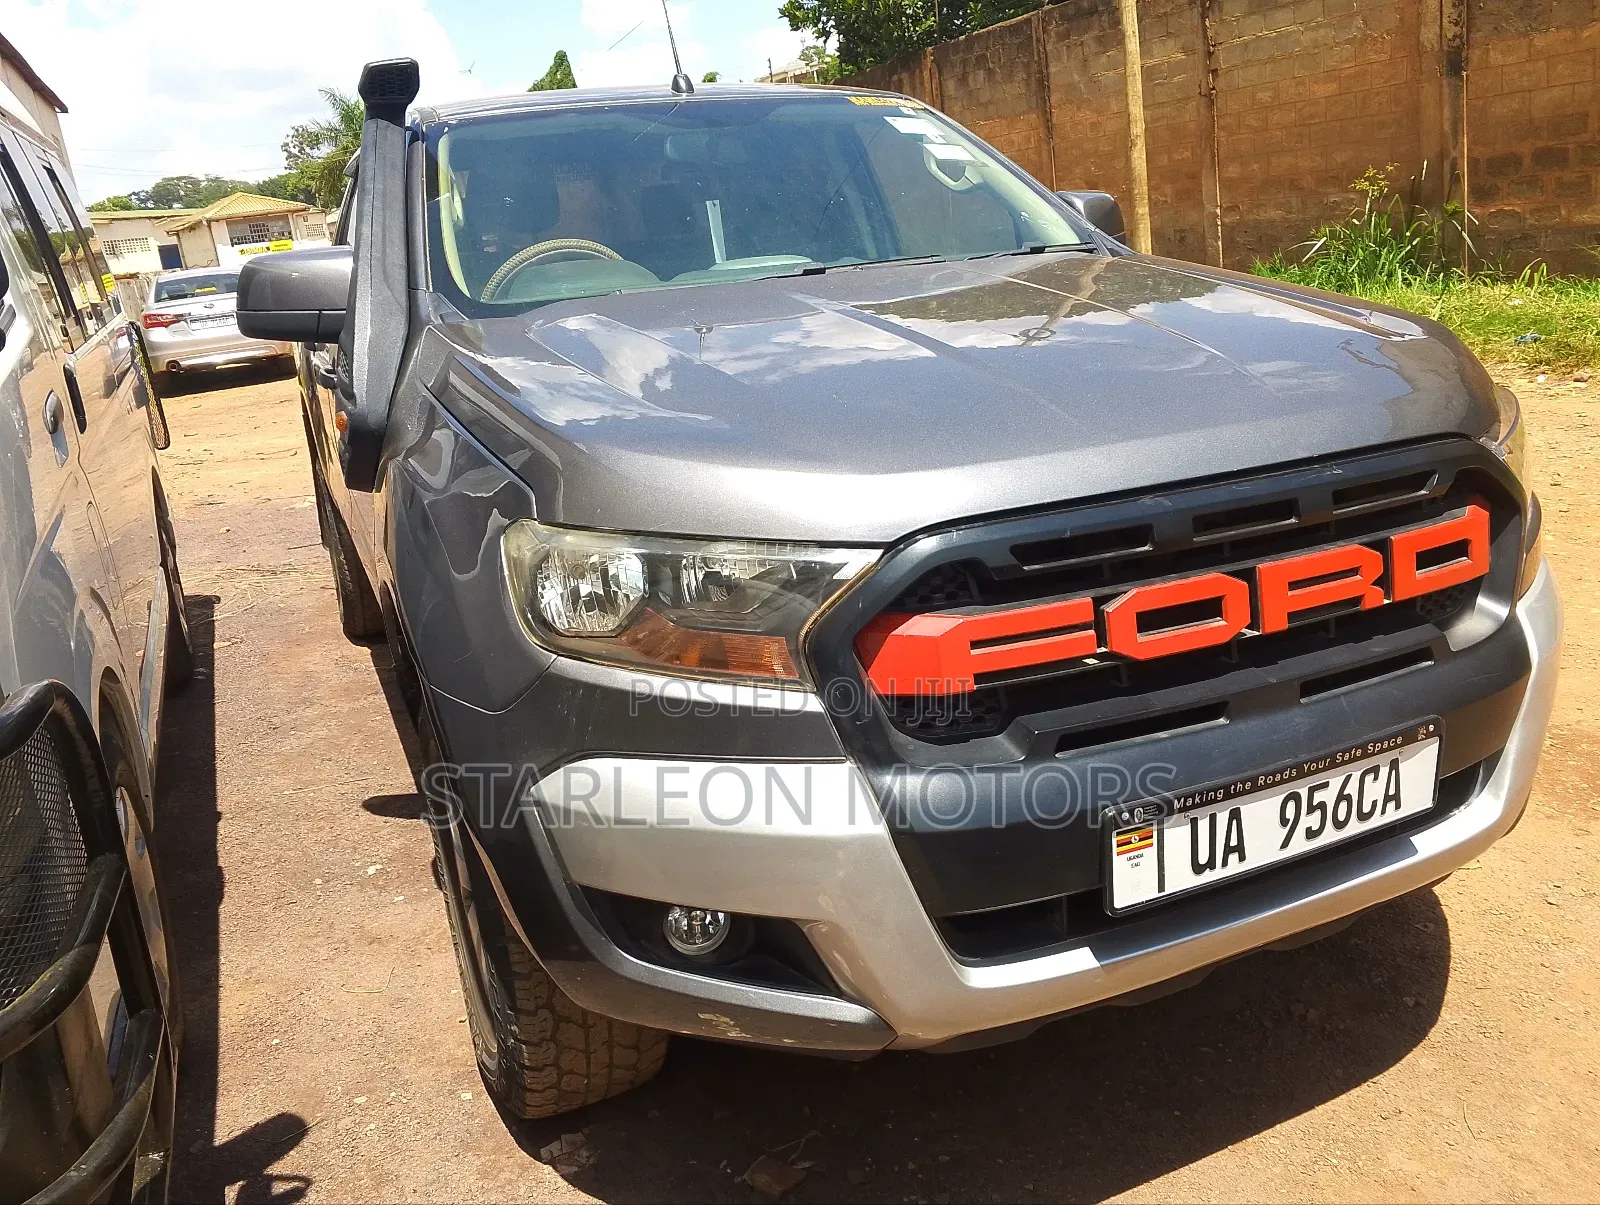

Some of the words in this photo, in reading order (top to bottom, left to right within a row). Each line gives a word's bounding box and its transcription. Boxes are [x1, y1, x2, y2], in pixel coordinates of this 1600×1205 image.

[855, 504, 1491, 696] FORD
[1173, 788, 1224, 810] Making
[1230, 780, 1252, 794] the
[1258, 767, 1298, 787] Roads
[1303, 757, 1331, 775] Your
[1336, 747, 1362, 764] Safe
[1368, 735, 1404, 755] Space
[1189, 806, 1246, 876] UA
[1279, 757, 1403, 851] 956CA
